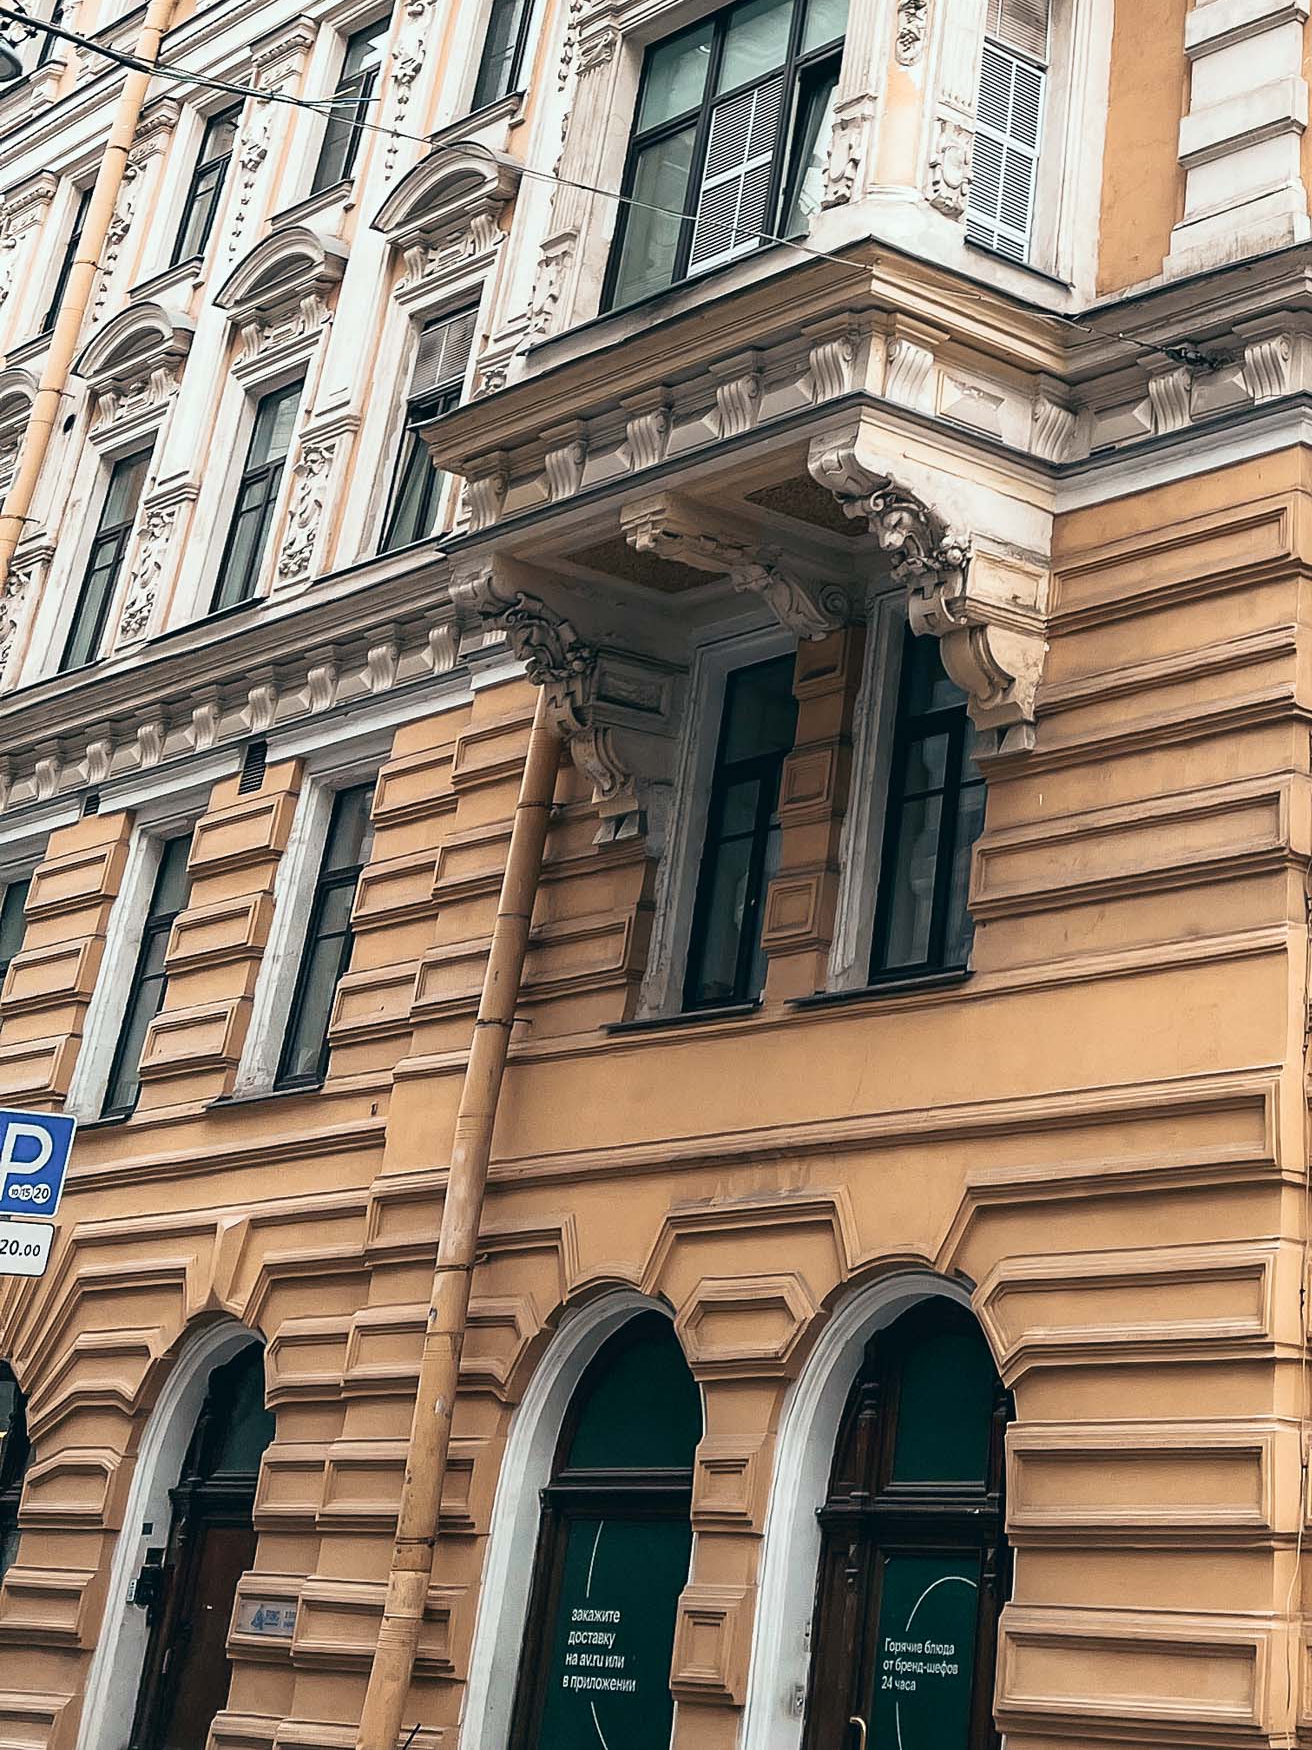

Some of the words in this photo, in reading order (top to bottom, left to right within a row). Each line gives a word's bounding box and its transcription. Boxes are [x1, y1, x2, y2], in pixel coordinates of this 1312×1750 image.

[0, 1122, 53, 1201] P
[21, 1187, 31, 1198] 15
[33, 1187, 49, 1199] 20
[0, 1238, 41, 1257] 20.00
[571, 1608, 621, 1623] закажите
[567, 1631, 616, 1649] доставку
[884, 1637, 923, 1655] Горячие
[924, 1640, 955, 1655] блюда
[565, 1653, 578, 1666] на
[579, 1654, 604, 1668] av.ru
[604, 1655, 625, 1669] или
[883, 1660, 894, 1671] от
[895, 1657, 959, 1678] бренд-шефов
[562, 1675, 569, 1688] в
[570, 1676, 636, 1693] приложении
[881, 1675, 893, 1690] 24
[895, 1679, 917, 1691] часа
